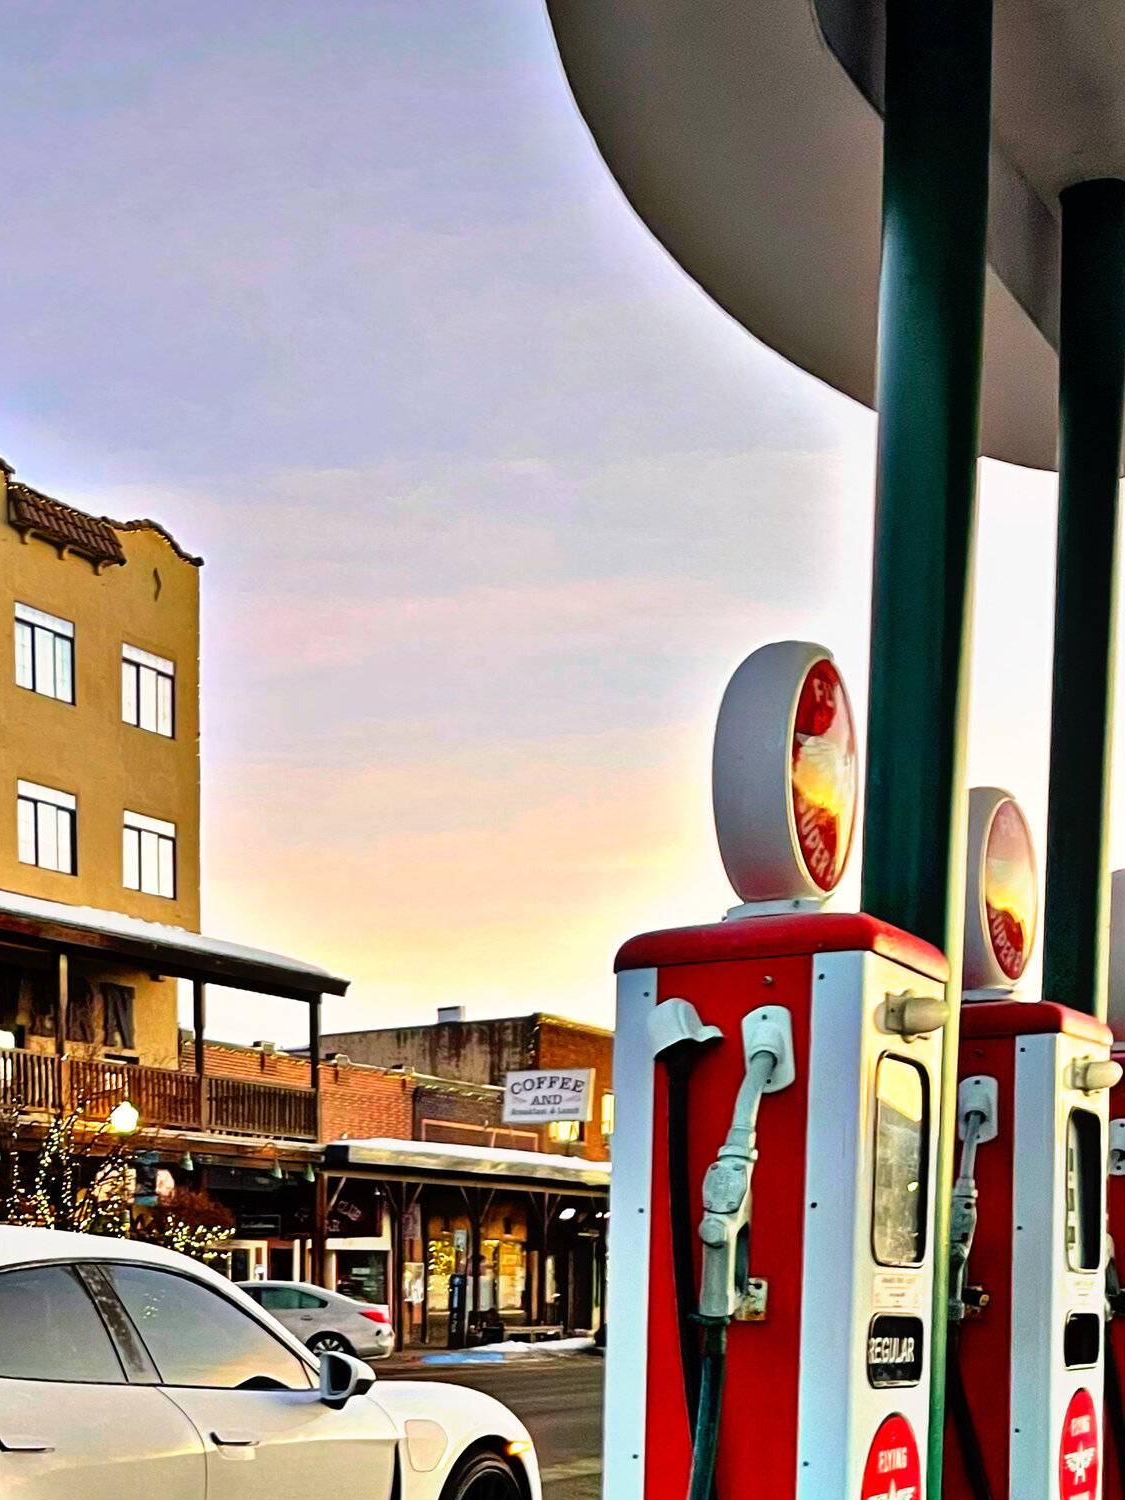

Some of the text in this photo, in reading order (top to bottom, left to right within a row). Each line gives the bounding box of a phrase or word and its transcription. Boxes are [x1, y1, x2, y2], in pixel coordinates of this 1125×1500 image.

[511, 1076, 585, 1095] COFFEE
[530, 1094, 563, 1106] AND
[868, 1337, 915, 1364] REGULAR
[878, 1447, 908, 1474] FLYING
